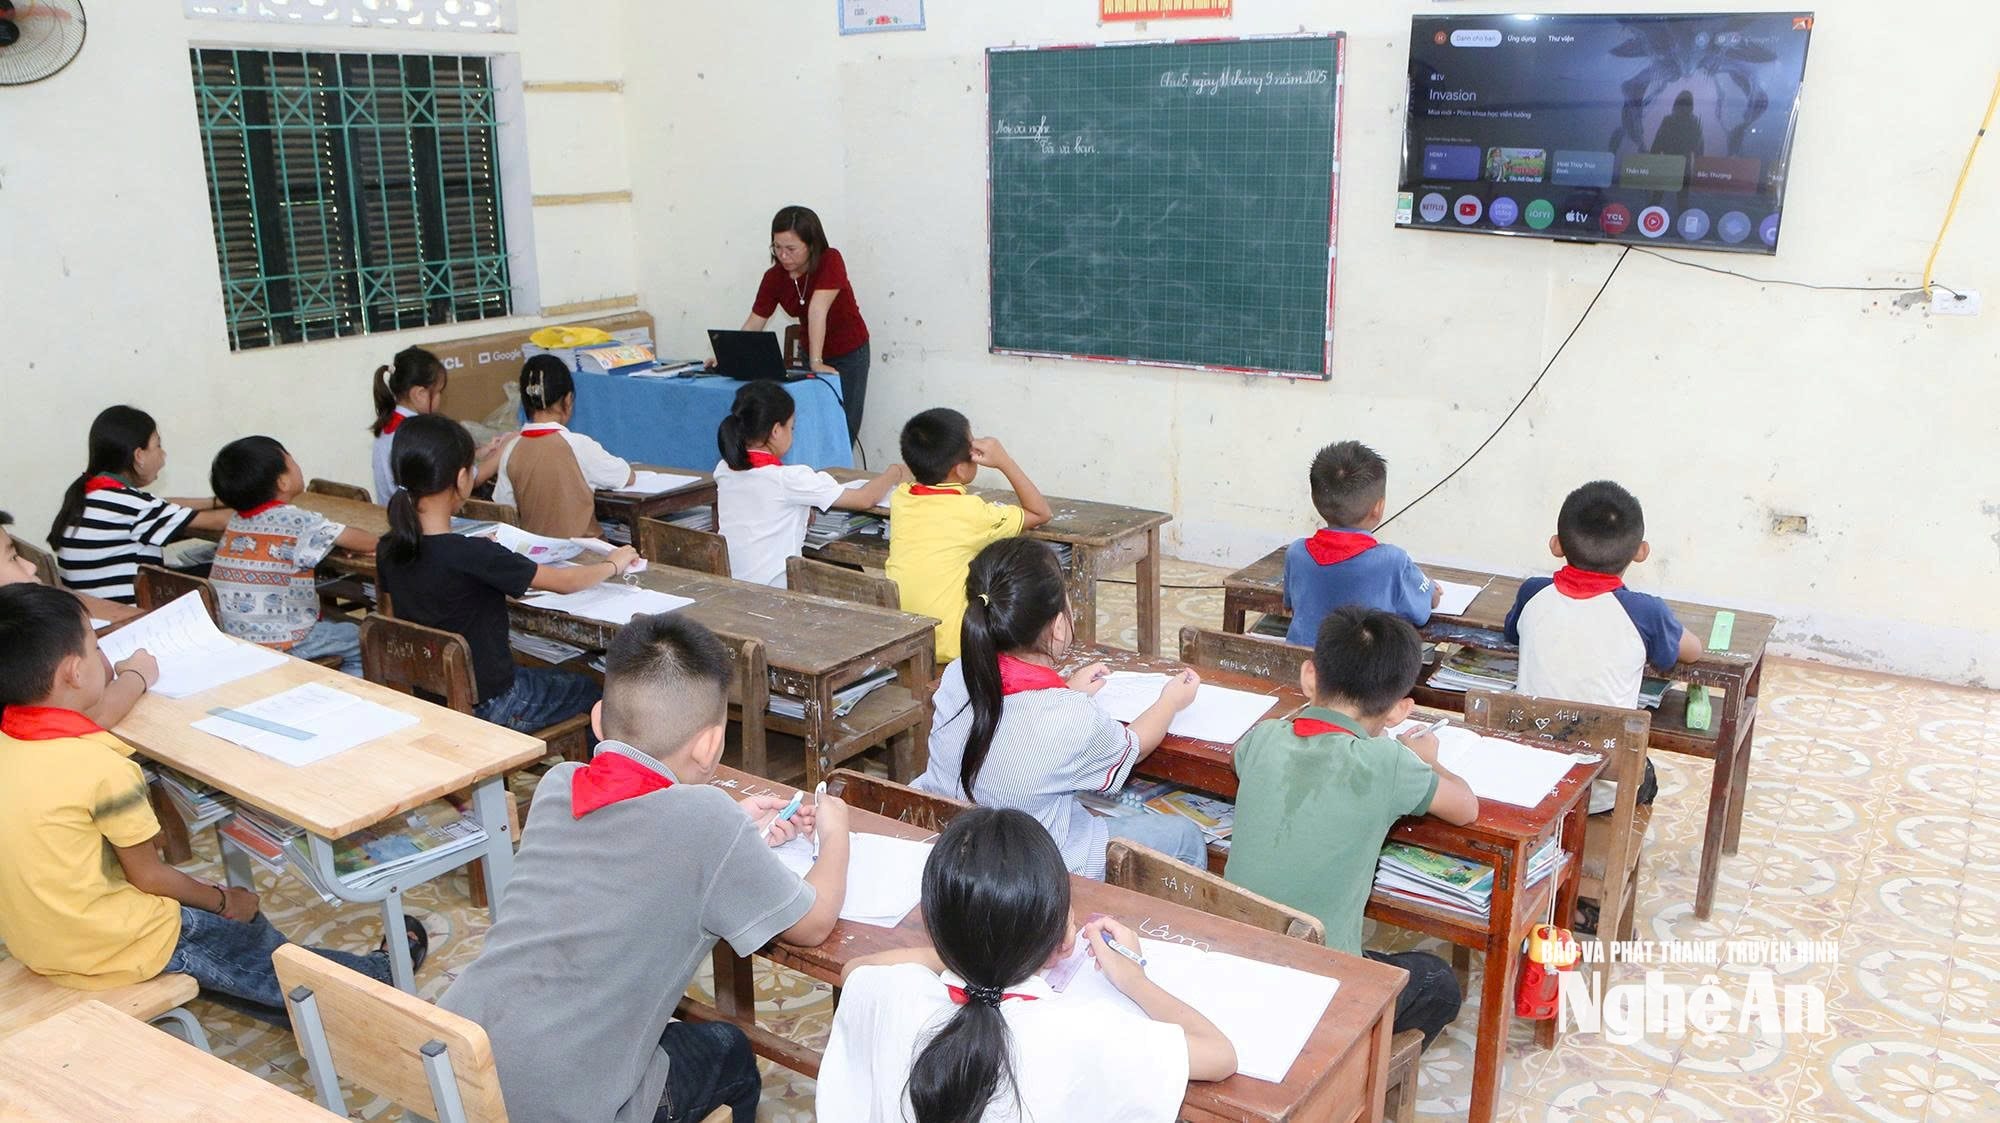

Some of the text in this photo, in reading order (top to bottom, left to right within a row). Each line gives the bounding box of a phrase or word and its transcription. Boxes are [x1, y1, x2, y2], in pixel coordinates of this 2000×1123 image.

[1192, 71, 1219, 95] ngày
[1230, 69, 1263, 95] tháng
[1265, 71, 1274, 86] 9
[1429, 89, 1477, 101] Invasion
[1422, 203, 1445, 211] NETFLIX
[1575, 211, 1588, 223] tv
[1606, 213, 1624, 221] TCL
[1139, 917, 1210, 954] Lâm
